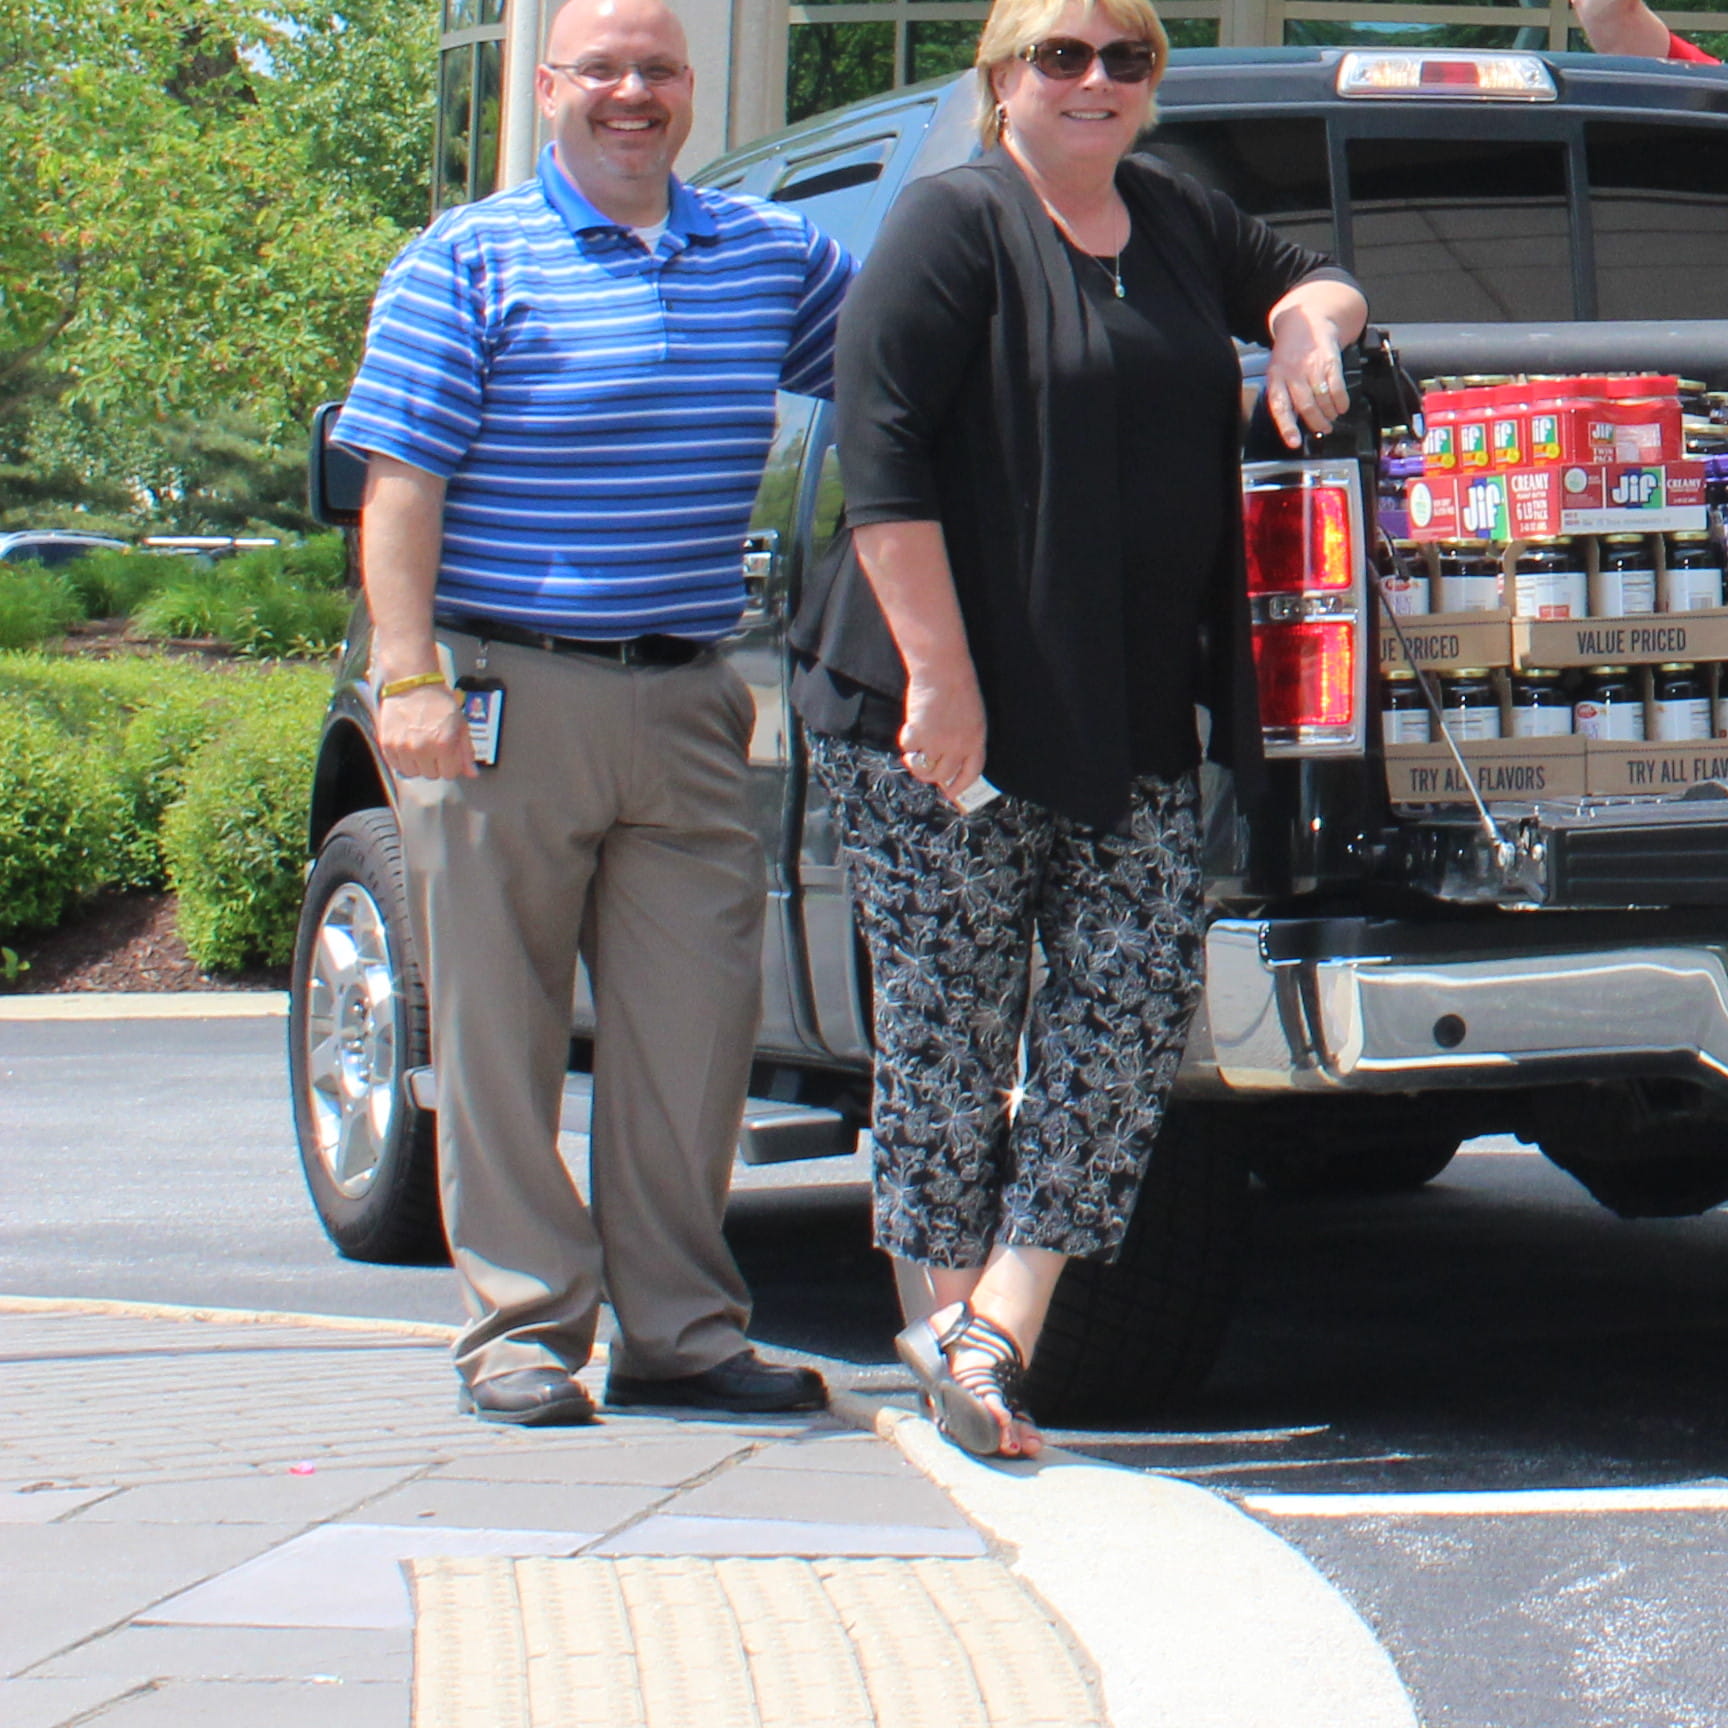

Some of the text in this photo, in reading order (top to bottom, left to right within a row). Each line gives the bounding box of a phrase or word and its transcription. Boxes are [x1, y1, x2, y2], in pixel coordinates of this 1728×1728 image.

[1511, 473, 1549, 492] CREAMY
[1612, 473, 1658, 504] Jif
[1667, 478, 1702, 489] CREAMY
[1463, 483, 1501, 532] Jif
[1577, 627, 1687, 655] VALUE PRICED
[1410, 765, 1546, 791] TRY AL FLAVORS
[1627, 759, 1656, 784] TRY
[1661, 759, 1687, 783] ALL
